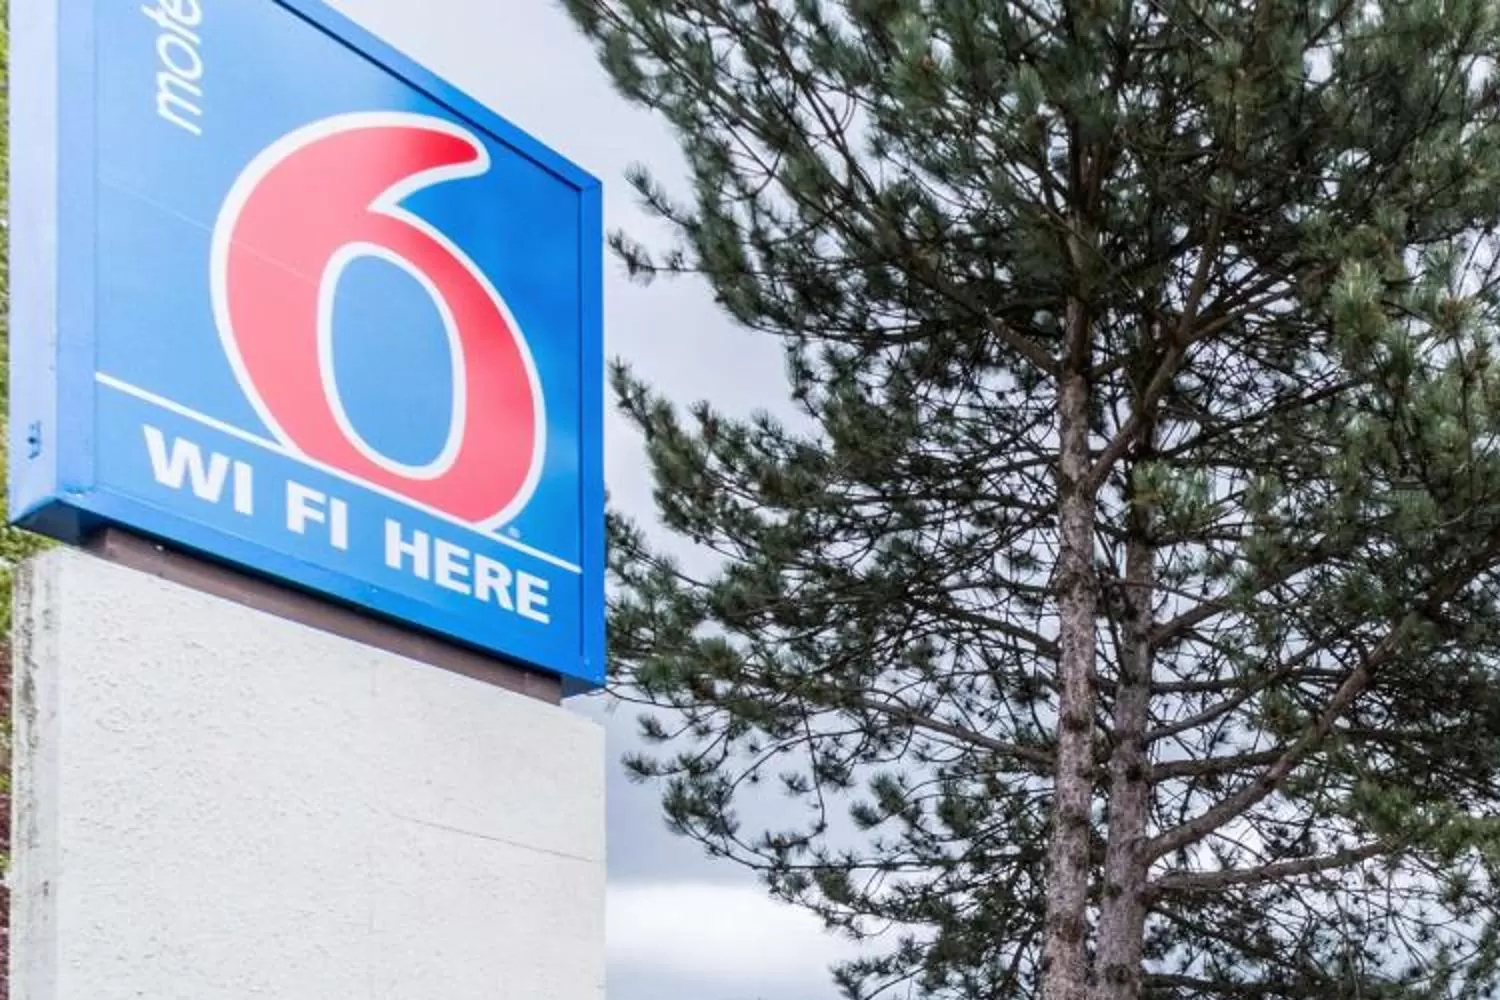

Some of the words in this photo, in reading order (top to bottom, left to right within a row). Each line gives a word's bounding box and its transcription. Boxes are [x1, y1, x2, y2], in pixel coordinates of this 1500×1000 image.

[210, 111, 546, 531] 6
[142, 424, 253, 515] WI
[286, 479, 348, 550] FI
[384, 517, 550, 624] HERE
